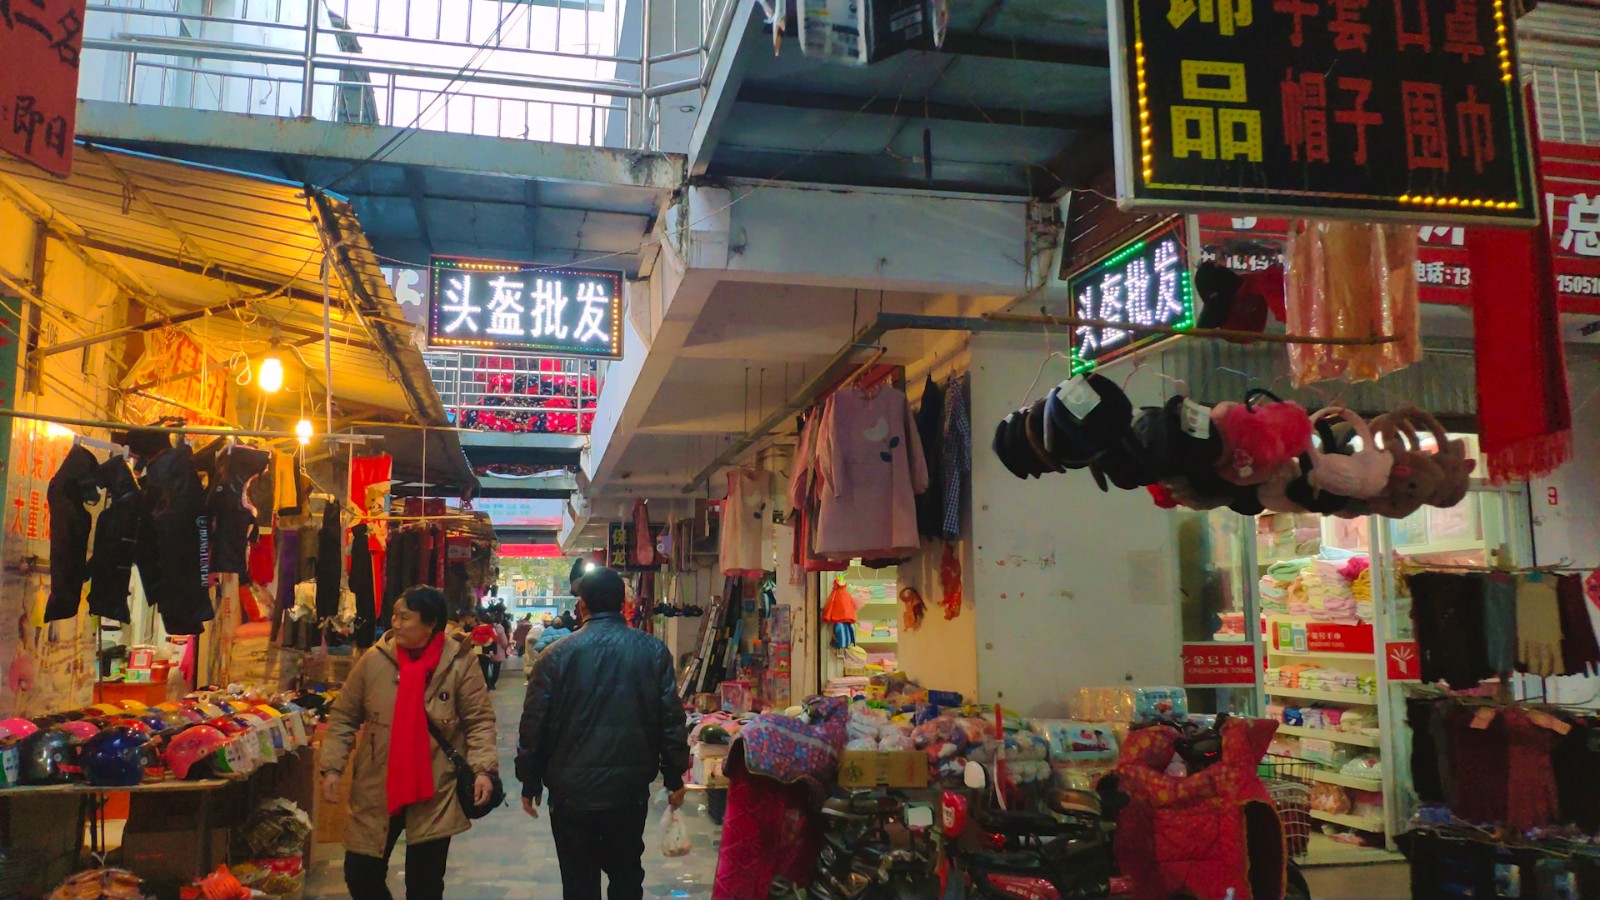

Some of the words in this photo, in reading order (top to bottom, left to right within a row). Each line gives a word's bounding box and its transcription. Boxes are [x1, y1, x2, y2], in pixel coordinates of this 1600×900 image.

[1280, 67, 1384, 165] 帽子
[442, 274, 609, 343] 头盔批发
[1075, 239, 1183, 359] 头盔批发
